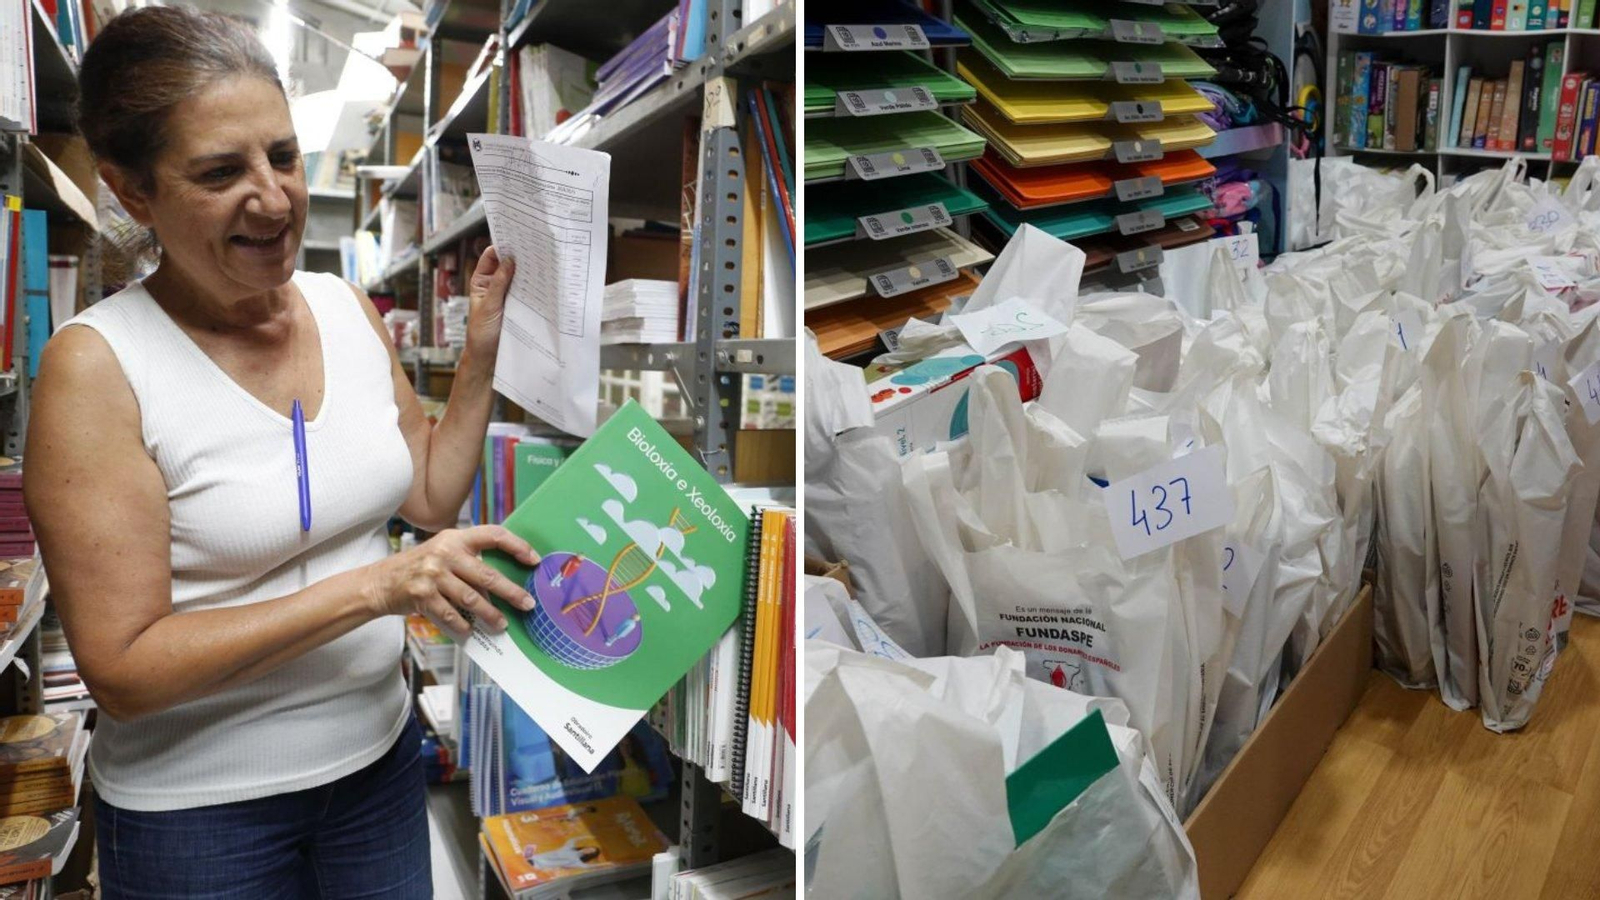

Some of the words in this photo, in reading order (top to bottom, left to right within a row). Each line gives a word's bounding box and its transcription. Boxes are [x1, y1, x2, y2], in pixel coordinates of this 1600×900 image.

[626, 426, 678, 481] Bioloxía
[676, 479, 688, 491] e
[685, 485, 737, 543] Xeoloxía
[1131, 477, 1191, 536] 437
[1015, 605, 1025, 613] Es
[1039, 607, 1071, 615] mensaje
[1073, 606, 1084, 614] de
[1085, 605, 1092, 614] la
[999, 613, 1058, 623] FUNDACIÓN
[1061, 616, 1106, 632] NACIONAL
[980, 642, 990, 650] LA
[1033, 642, 1043, 650] DE
[1044, 644, 1057, 652] LOS
[1016, 626, 1094, 648] FUNDASPE
[1513, 660, 1526, 672] 70
[564, 722, 595, 754] Santillana
